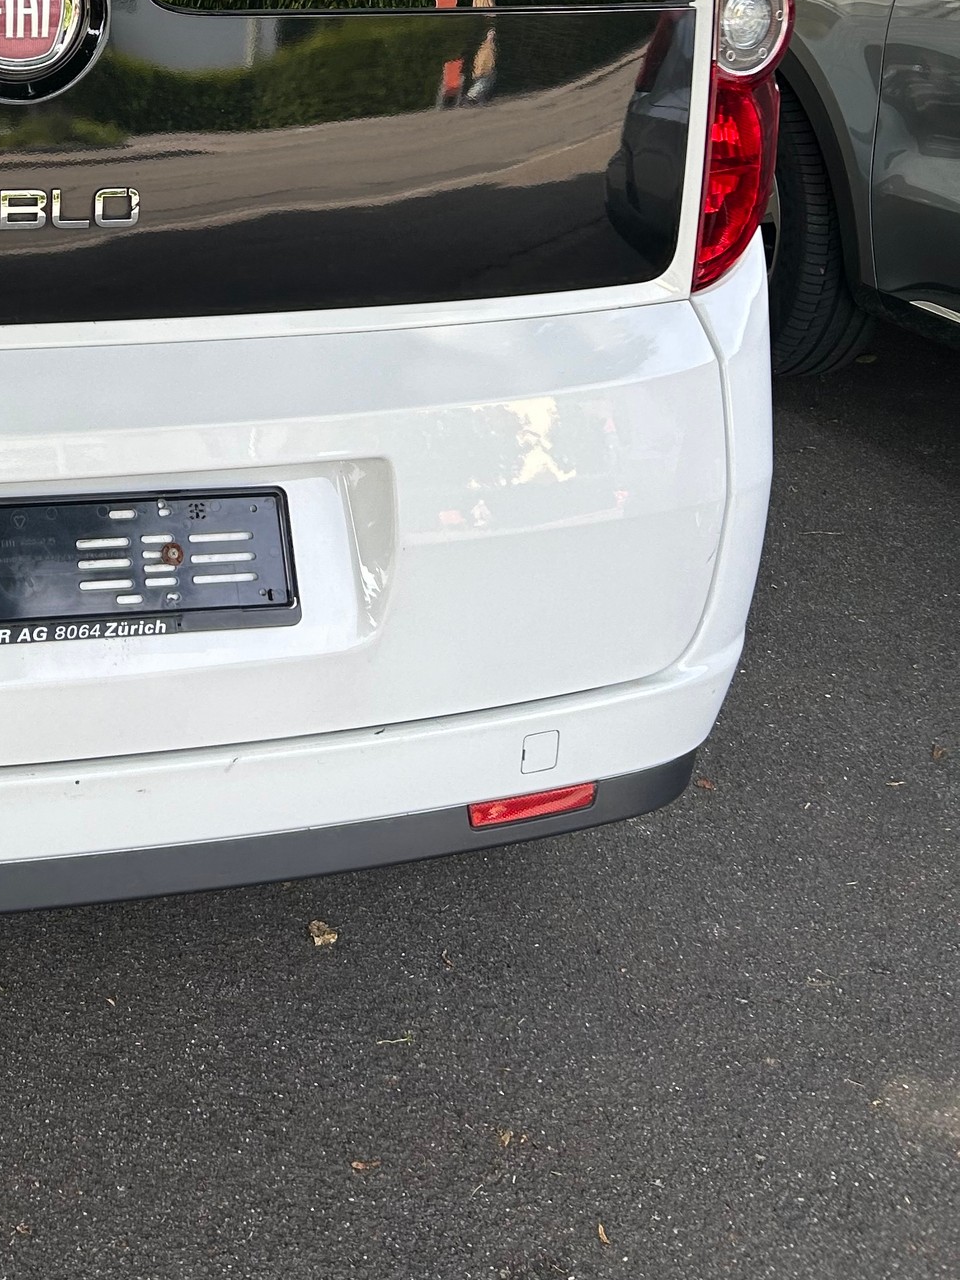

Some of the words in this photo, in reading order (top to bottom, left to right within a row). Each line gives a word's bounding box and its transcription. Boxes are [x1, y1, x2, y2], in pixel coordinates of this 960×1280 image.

[17, 626, 48, 642] AG
[55, 623, 101, 640] 8064
[104, 620, 167, 638] Zürich
